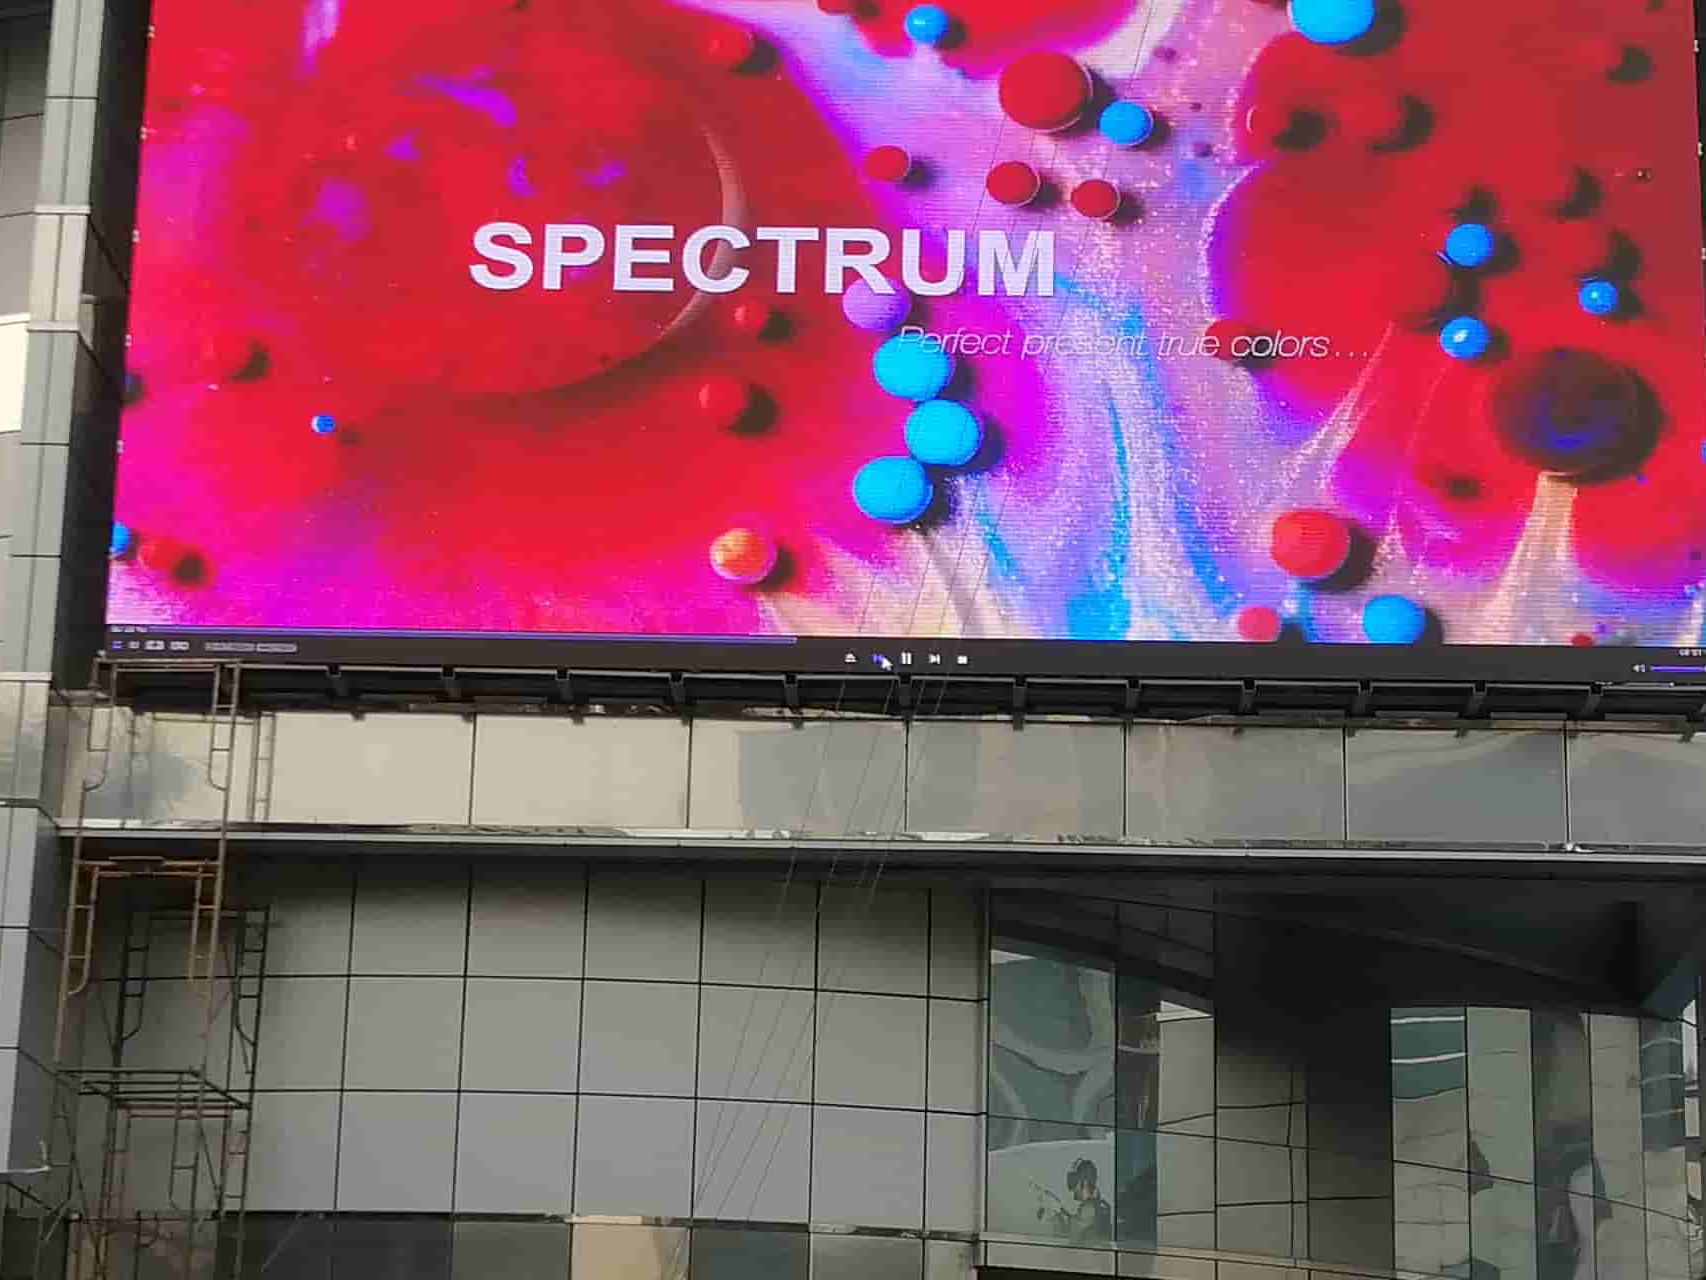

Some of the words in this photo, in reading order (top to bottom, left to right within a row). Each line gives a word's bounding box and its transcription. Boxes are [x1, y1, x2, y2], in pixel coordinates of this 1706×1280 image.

[469, 222, 1054, 297] SPECTRUM
[897, 326, 1012, 357] Perfect
[1020, 330, 1148, 360] present
[1157, 330, 1221, 357] true
